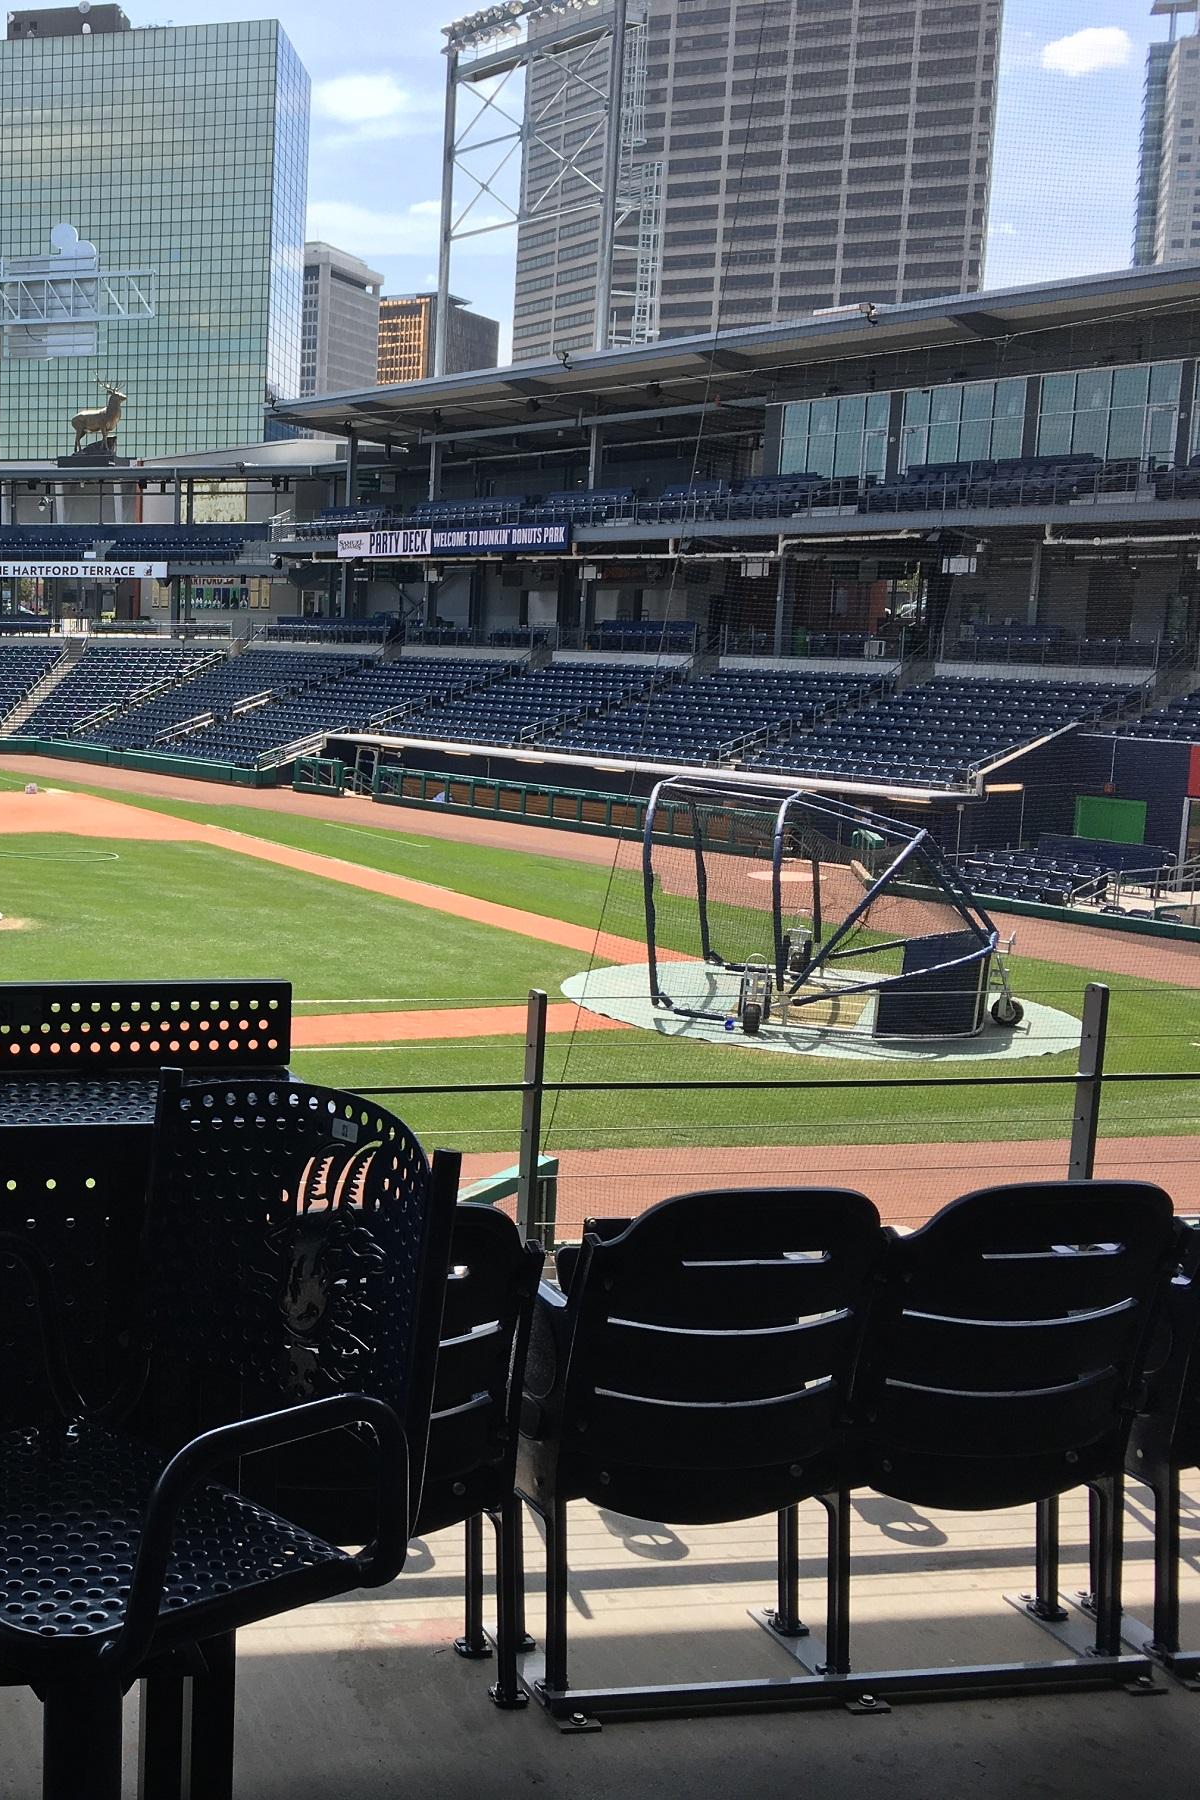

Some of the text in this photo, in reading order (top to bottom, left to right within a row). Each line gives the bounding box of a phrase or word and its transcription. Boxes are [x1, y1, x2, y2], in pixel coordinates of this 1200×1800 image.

[369, 531, 427, 554] PARTY DECK
[433, 526, 565, 548] WELCOME TO DUNKIN' DONUTS PARK
[13, 566, 79, 575] HARTFORD
[82, 566, 135, 576] TERRACE
